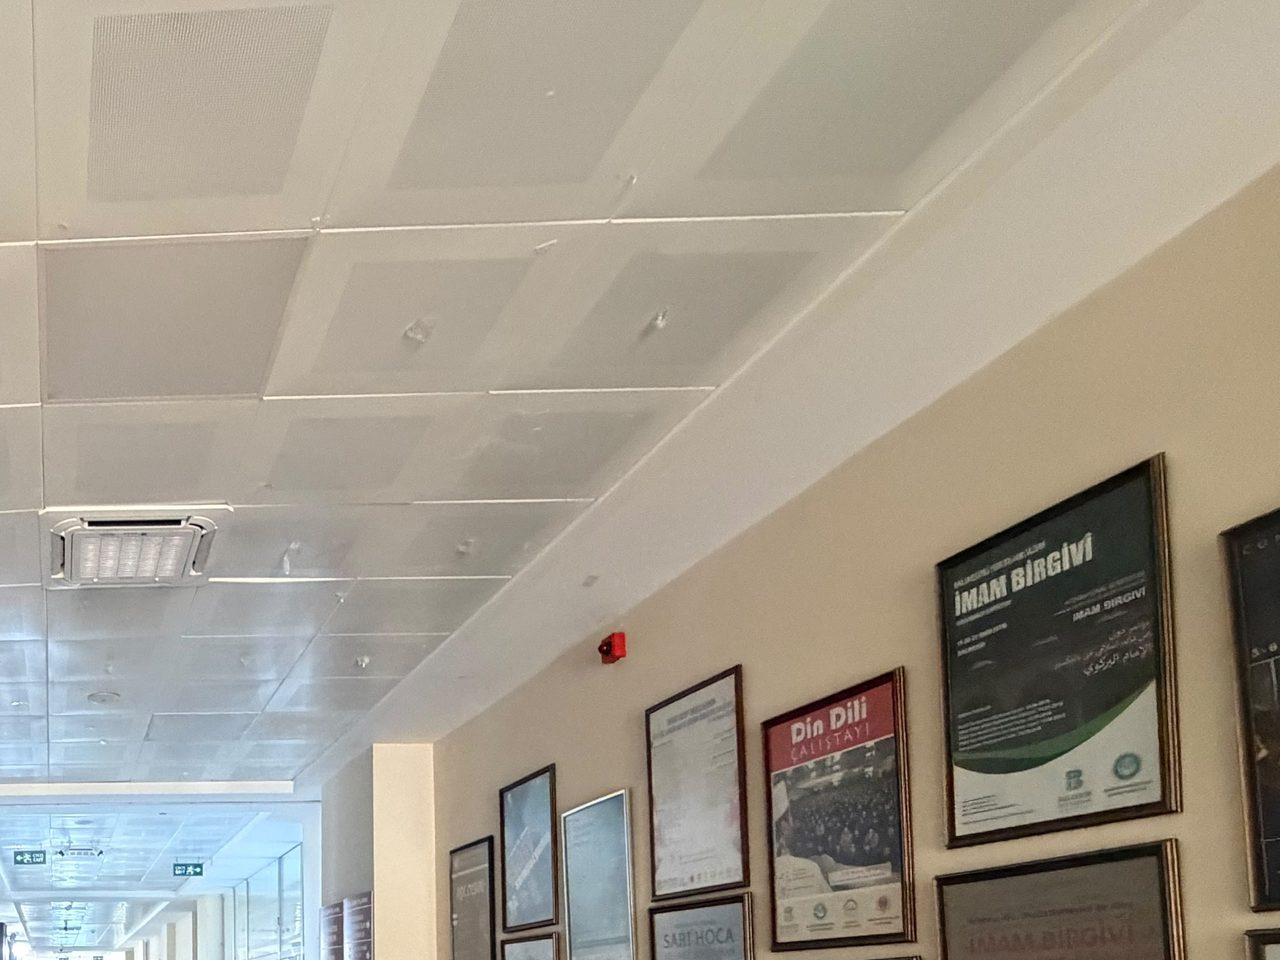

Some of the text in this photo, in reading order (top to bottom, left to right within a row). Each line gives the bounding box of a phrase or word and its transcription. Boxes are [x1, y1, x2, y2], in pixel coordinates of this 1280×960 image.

[954, 575, 1007, 617] İMAM
[790, 696, 868, 745] Din Dili
[790, 722, 870, 765] ÇALIŞTAYI
[663, 927, 735, 948] SARI HOCA
